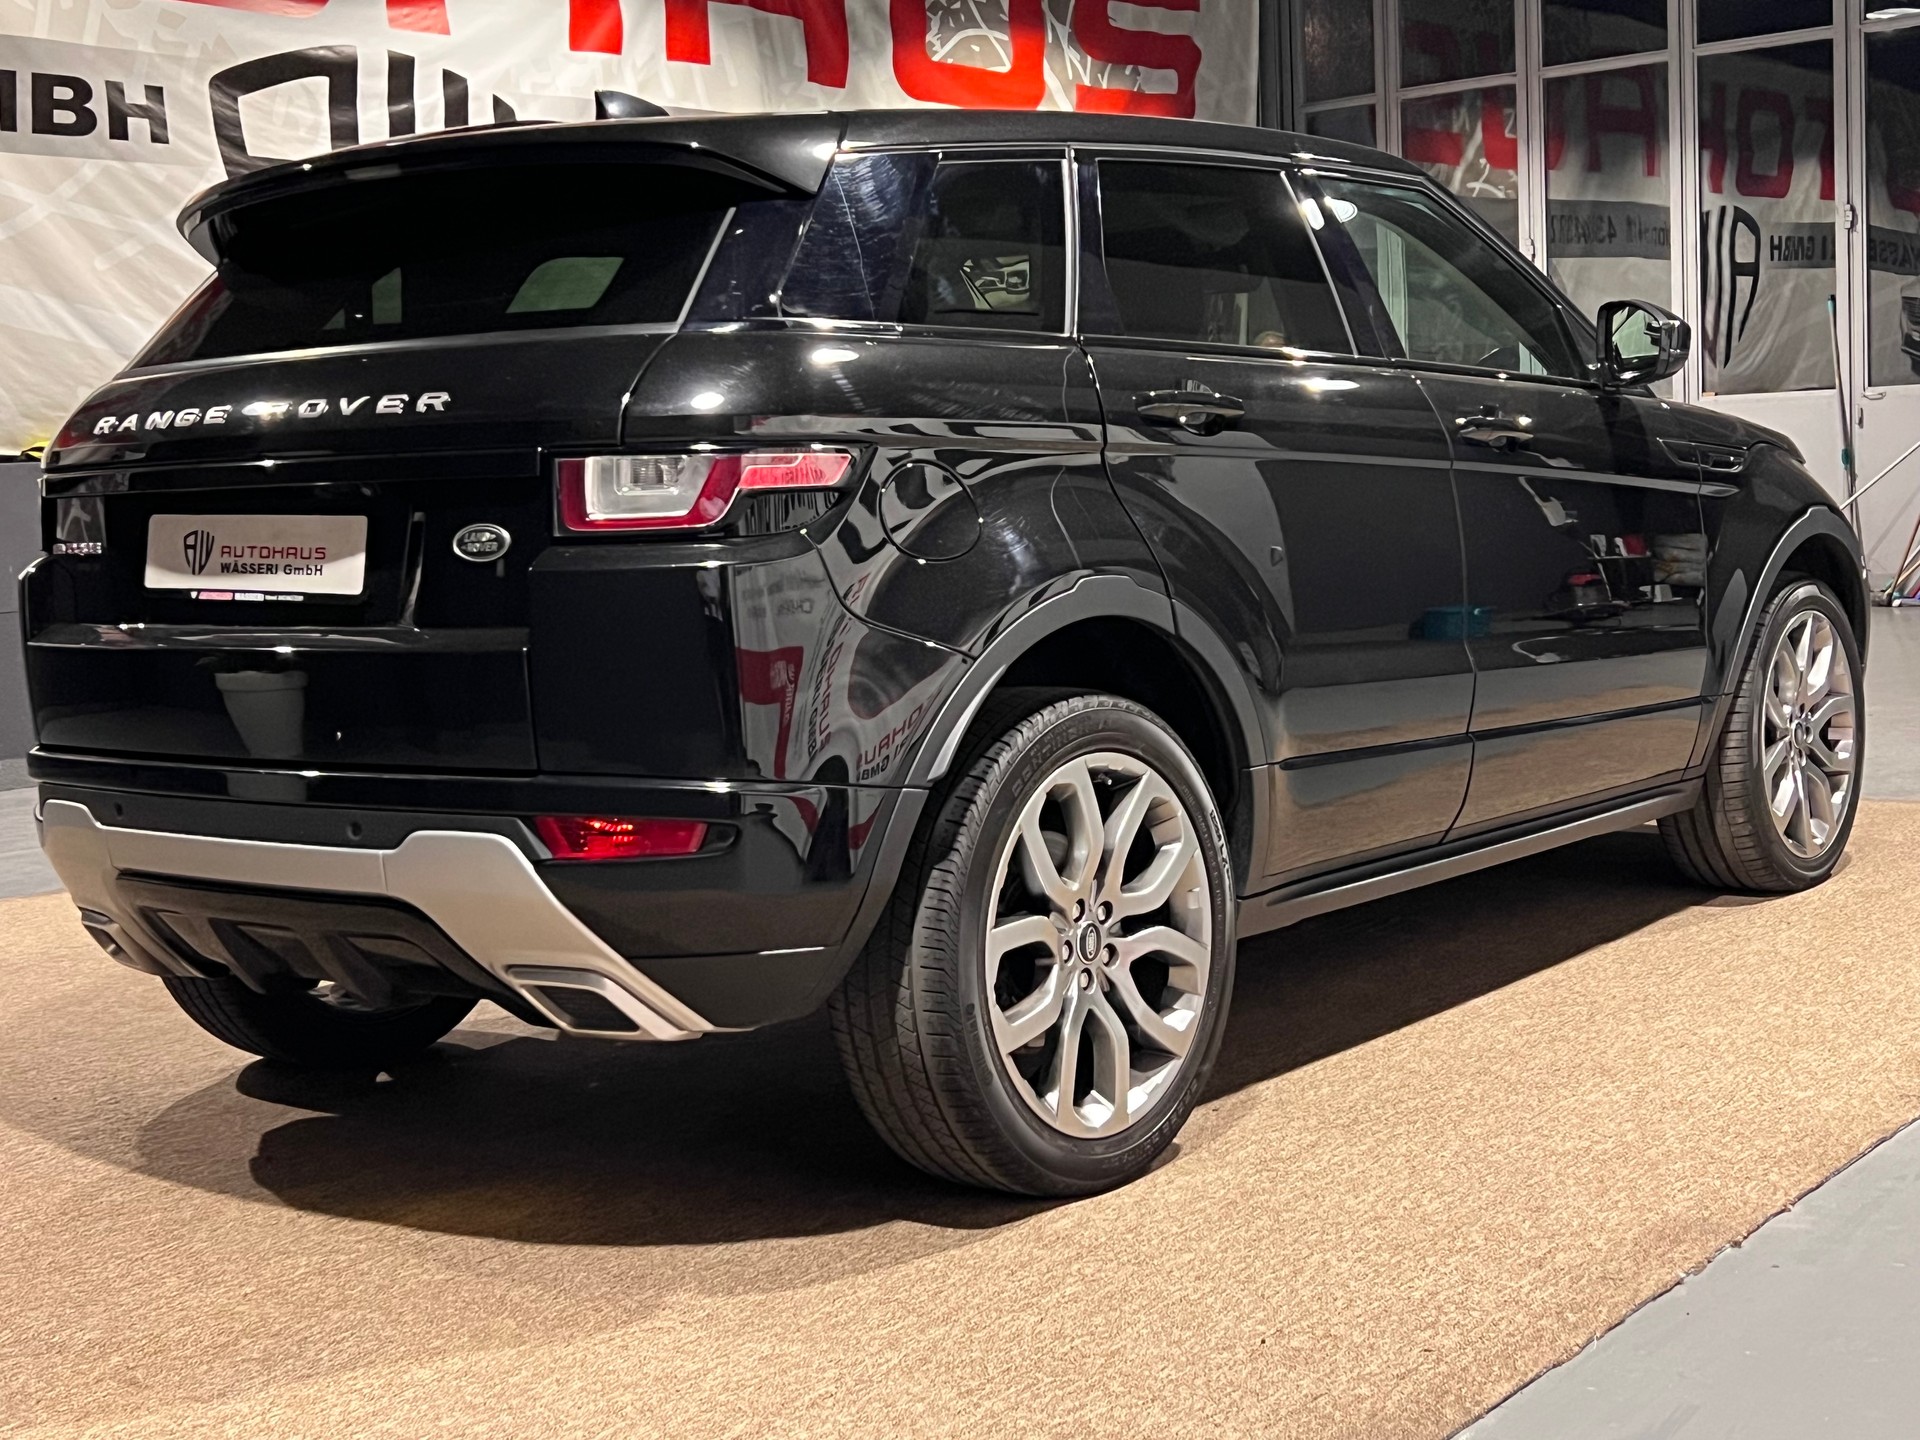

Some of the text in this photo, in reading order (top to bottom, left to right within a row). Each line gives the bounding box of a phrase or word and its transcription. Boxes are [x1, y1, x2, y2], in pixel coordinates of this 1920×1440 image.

[93, 405, 232, 436] RANGE
[220, 545, 327, 560] AUTOHAUS
[283, 564, 324, 576] GmbH
